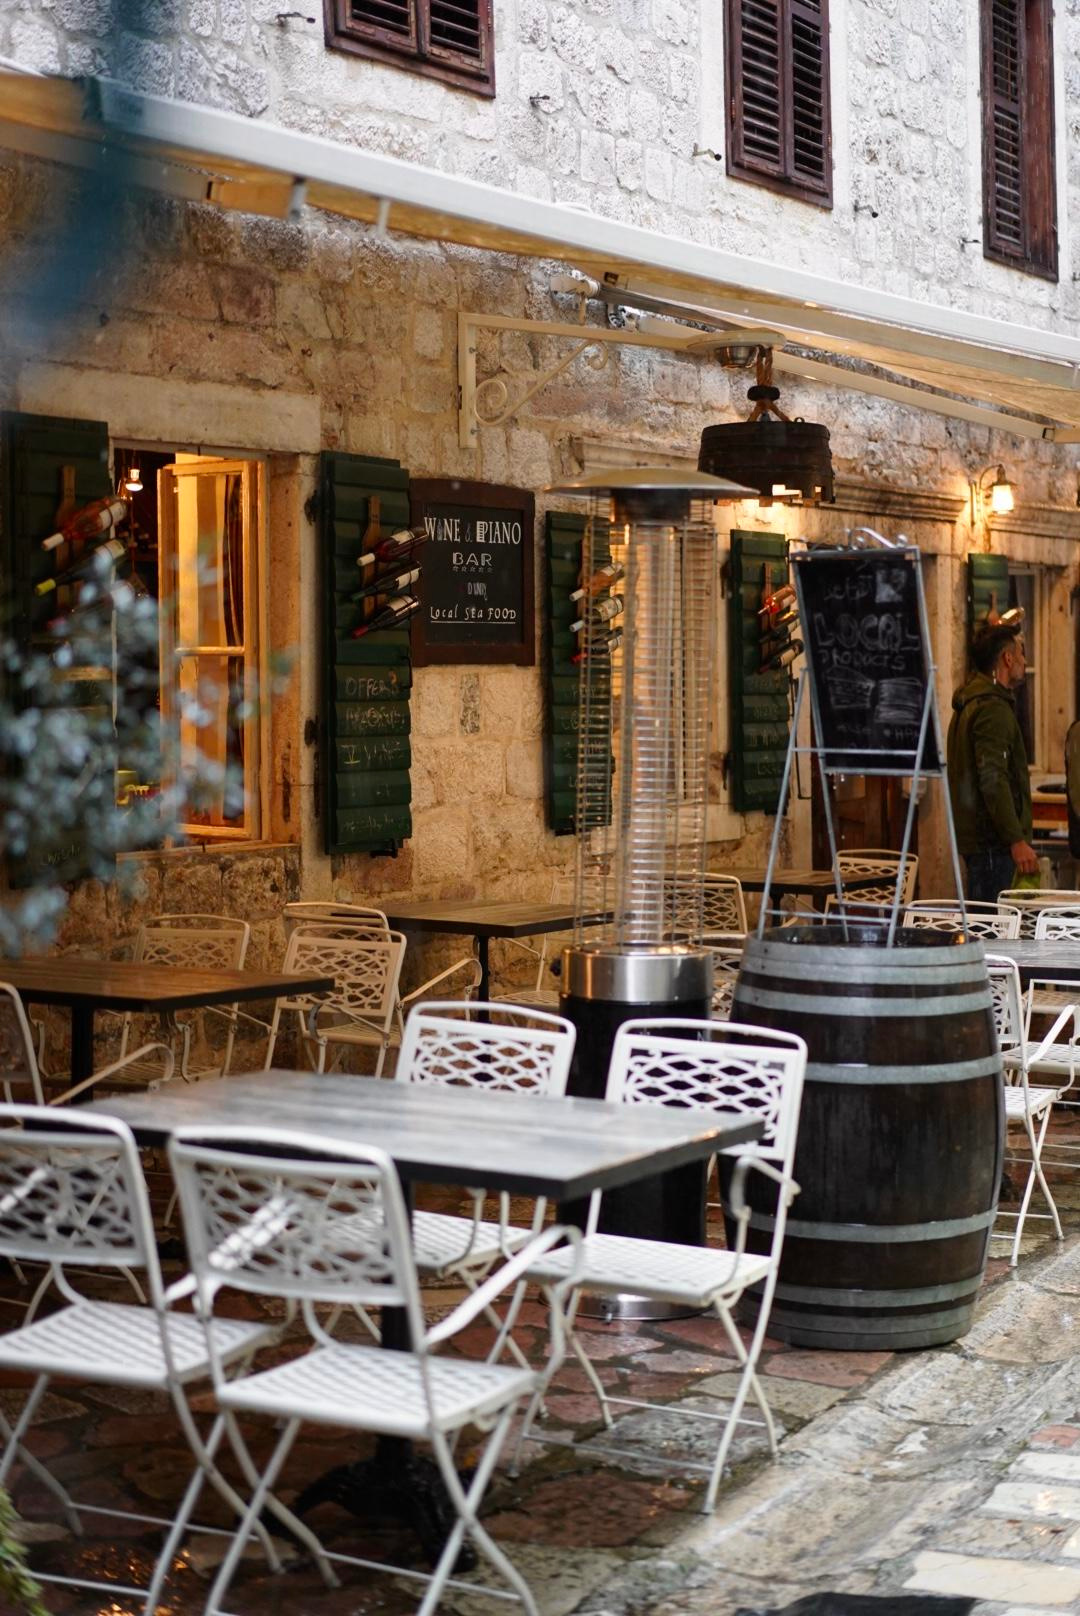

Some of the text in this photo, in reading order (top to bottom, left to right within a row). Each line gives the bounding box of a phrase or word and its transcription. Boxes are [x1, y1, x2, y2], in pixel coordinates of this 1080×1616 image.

[424, 517, 460, 543] WINE
[476, 520, 522, 545] PIANO
[452, 552, 492, 566] BAR
